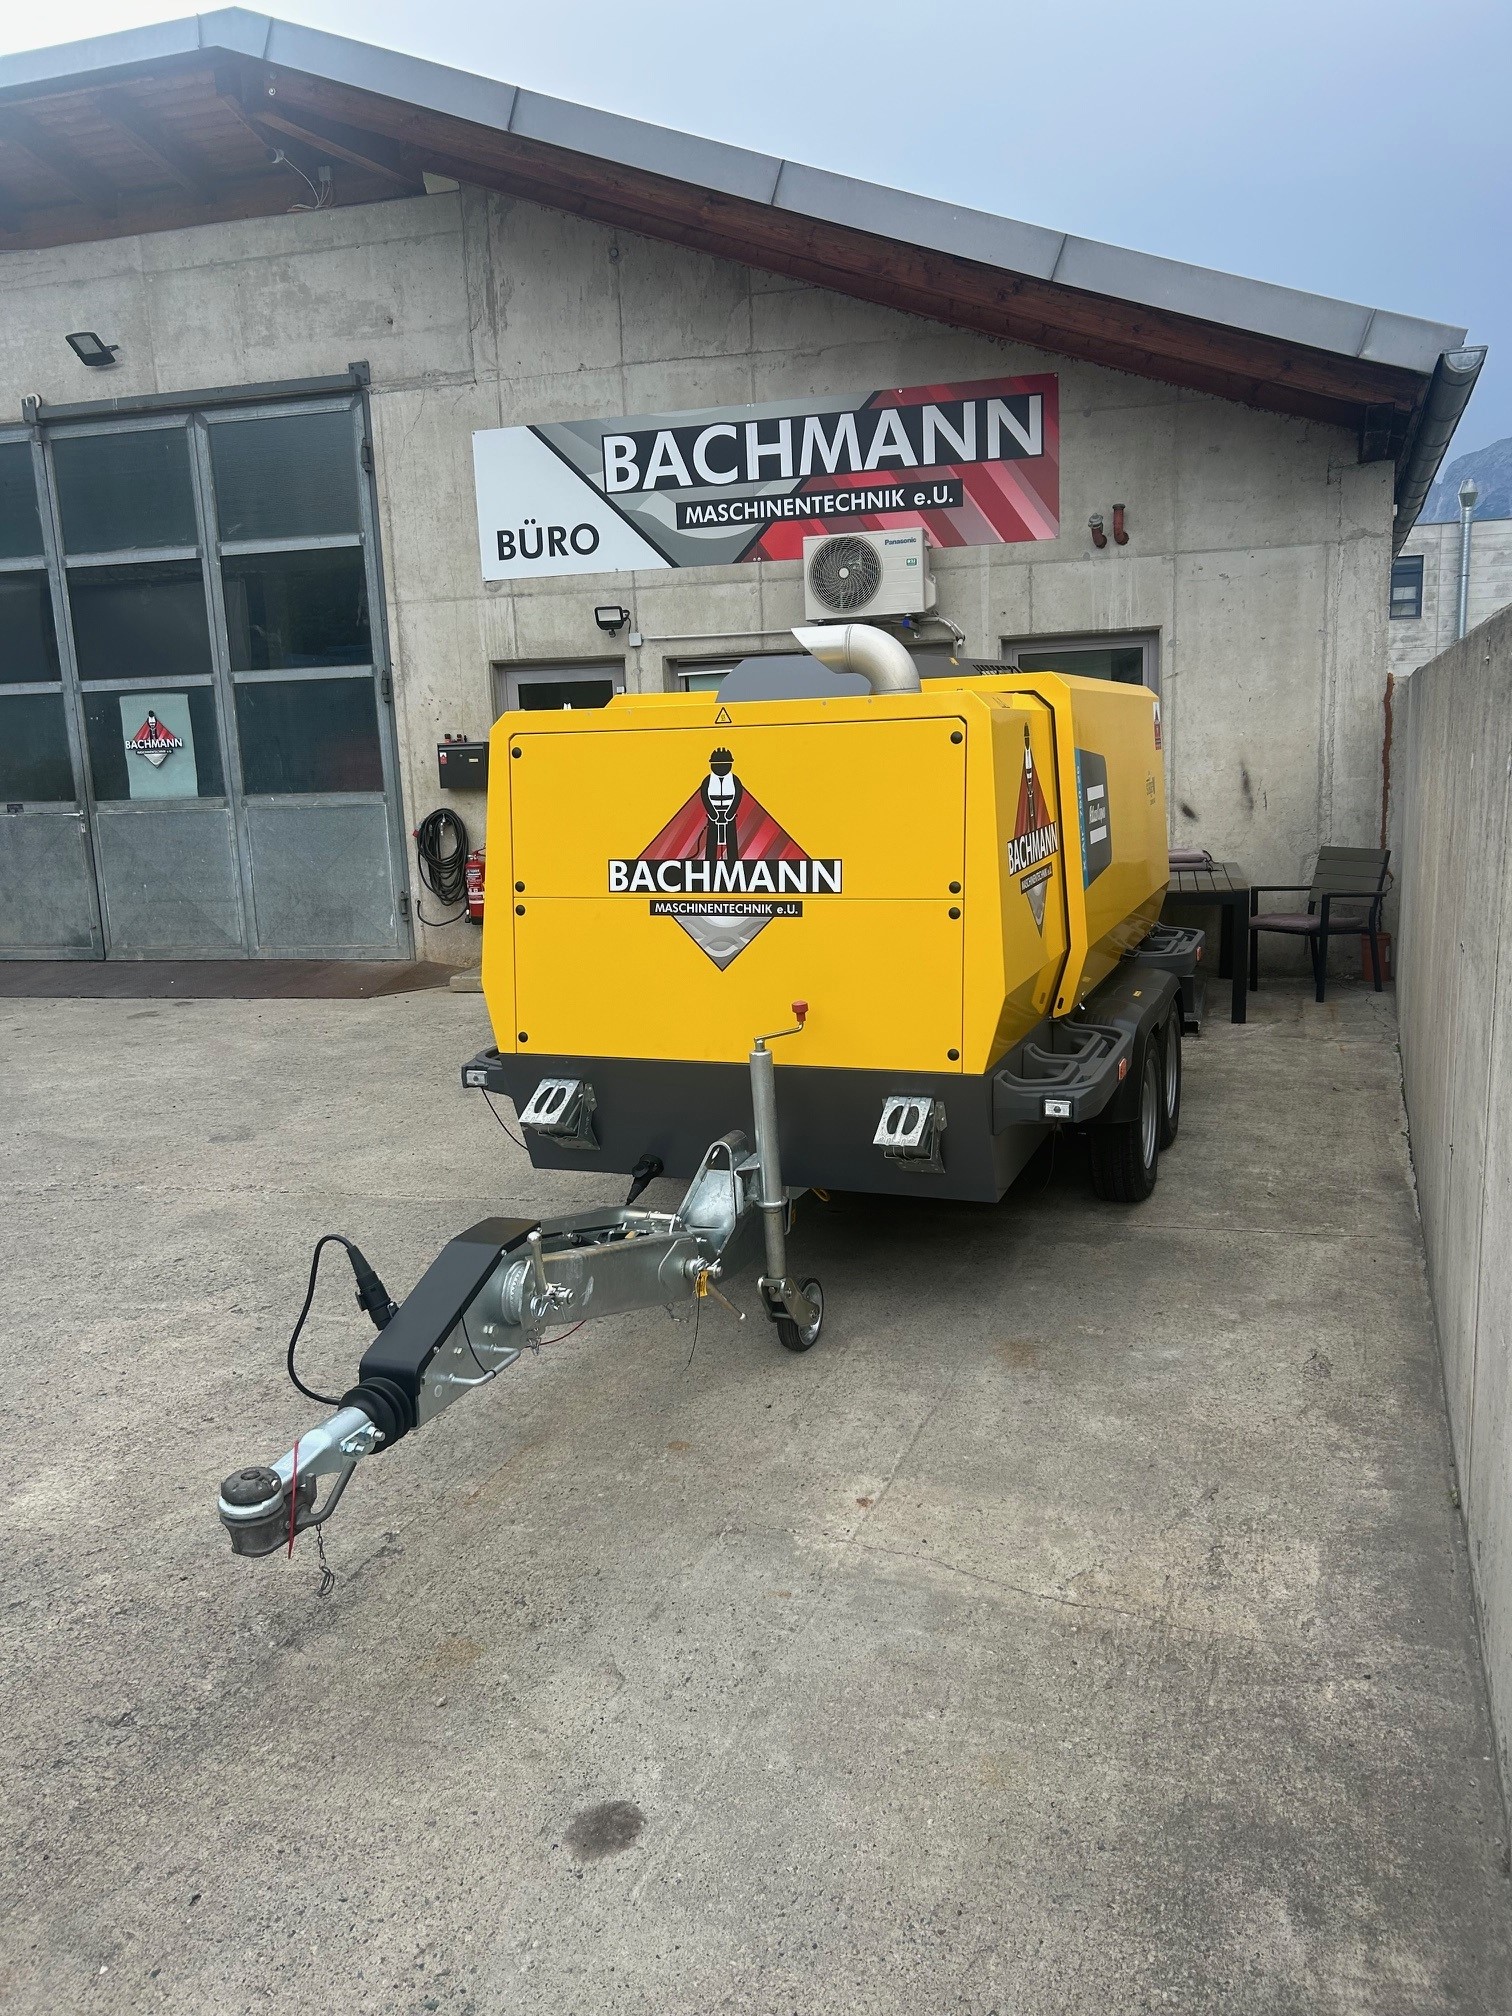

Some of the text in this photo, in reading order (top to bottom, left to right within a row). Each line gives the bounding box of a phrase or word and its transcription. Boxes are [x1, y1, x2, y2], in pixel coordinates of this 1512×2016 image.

[603, 394, 1043, 493] BACHMANN
[685, 485, 954, 524] MASCHINENTECHNIK e.U.
[496, 518, 600, 561] BÜRO
[884, 536, 917, 546] Panasonic
[125, 738, 182, 750] BACHMANN
[1007, 821, 1059, 875] BACHMANN
[609, 860, 842, 893] BACHMANN
[655, 902, 799, 915] MASCHINENTECHNIK e.U.
